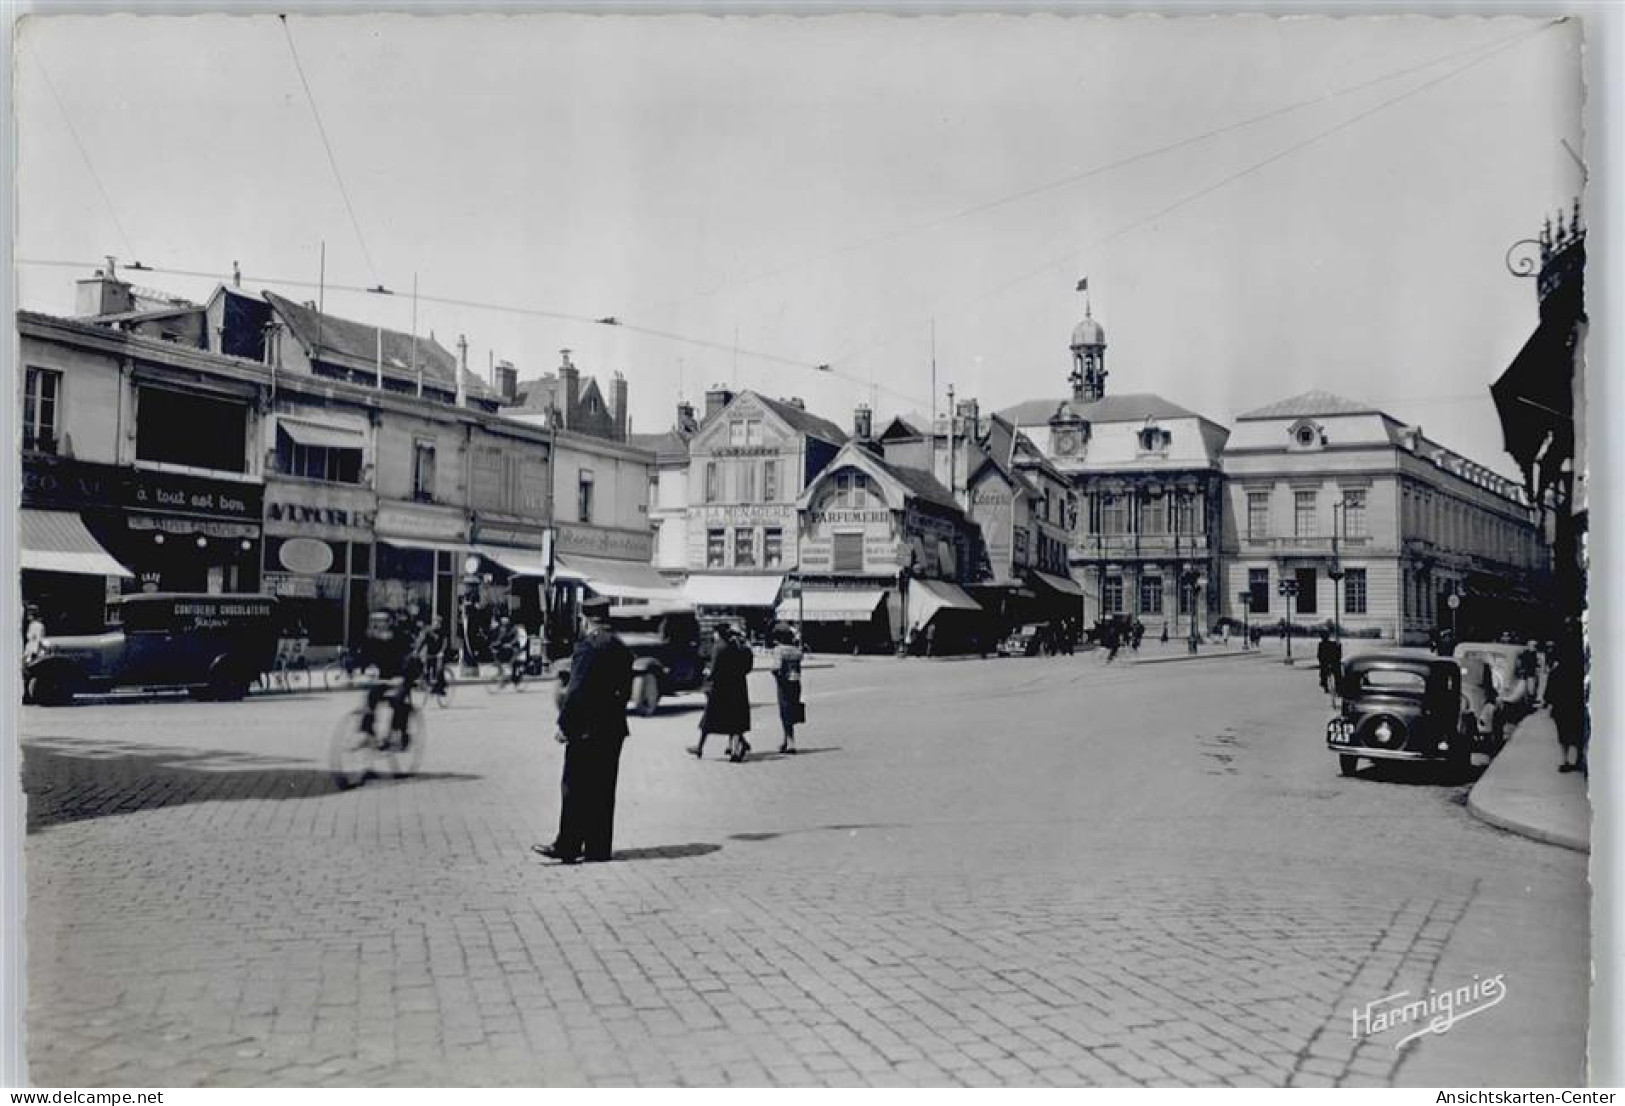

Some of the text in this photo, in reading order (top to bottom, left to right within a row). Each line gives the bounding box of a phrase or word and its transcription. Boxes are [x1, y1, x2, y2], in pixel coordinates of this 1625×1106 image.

[157, 488, 186, 504] tout
[191, 494, 214, 508] est
[219, 495, 246, 511] bon
